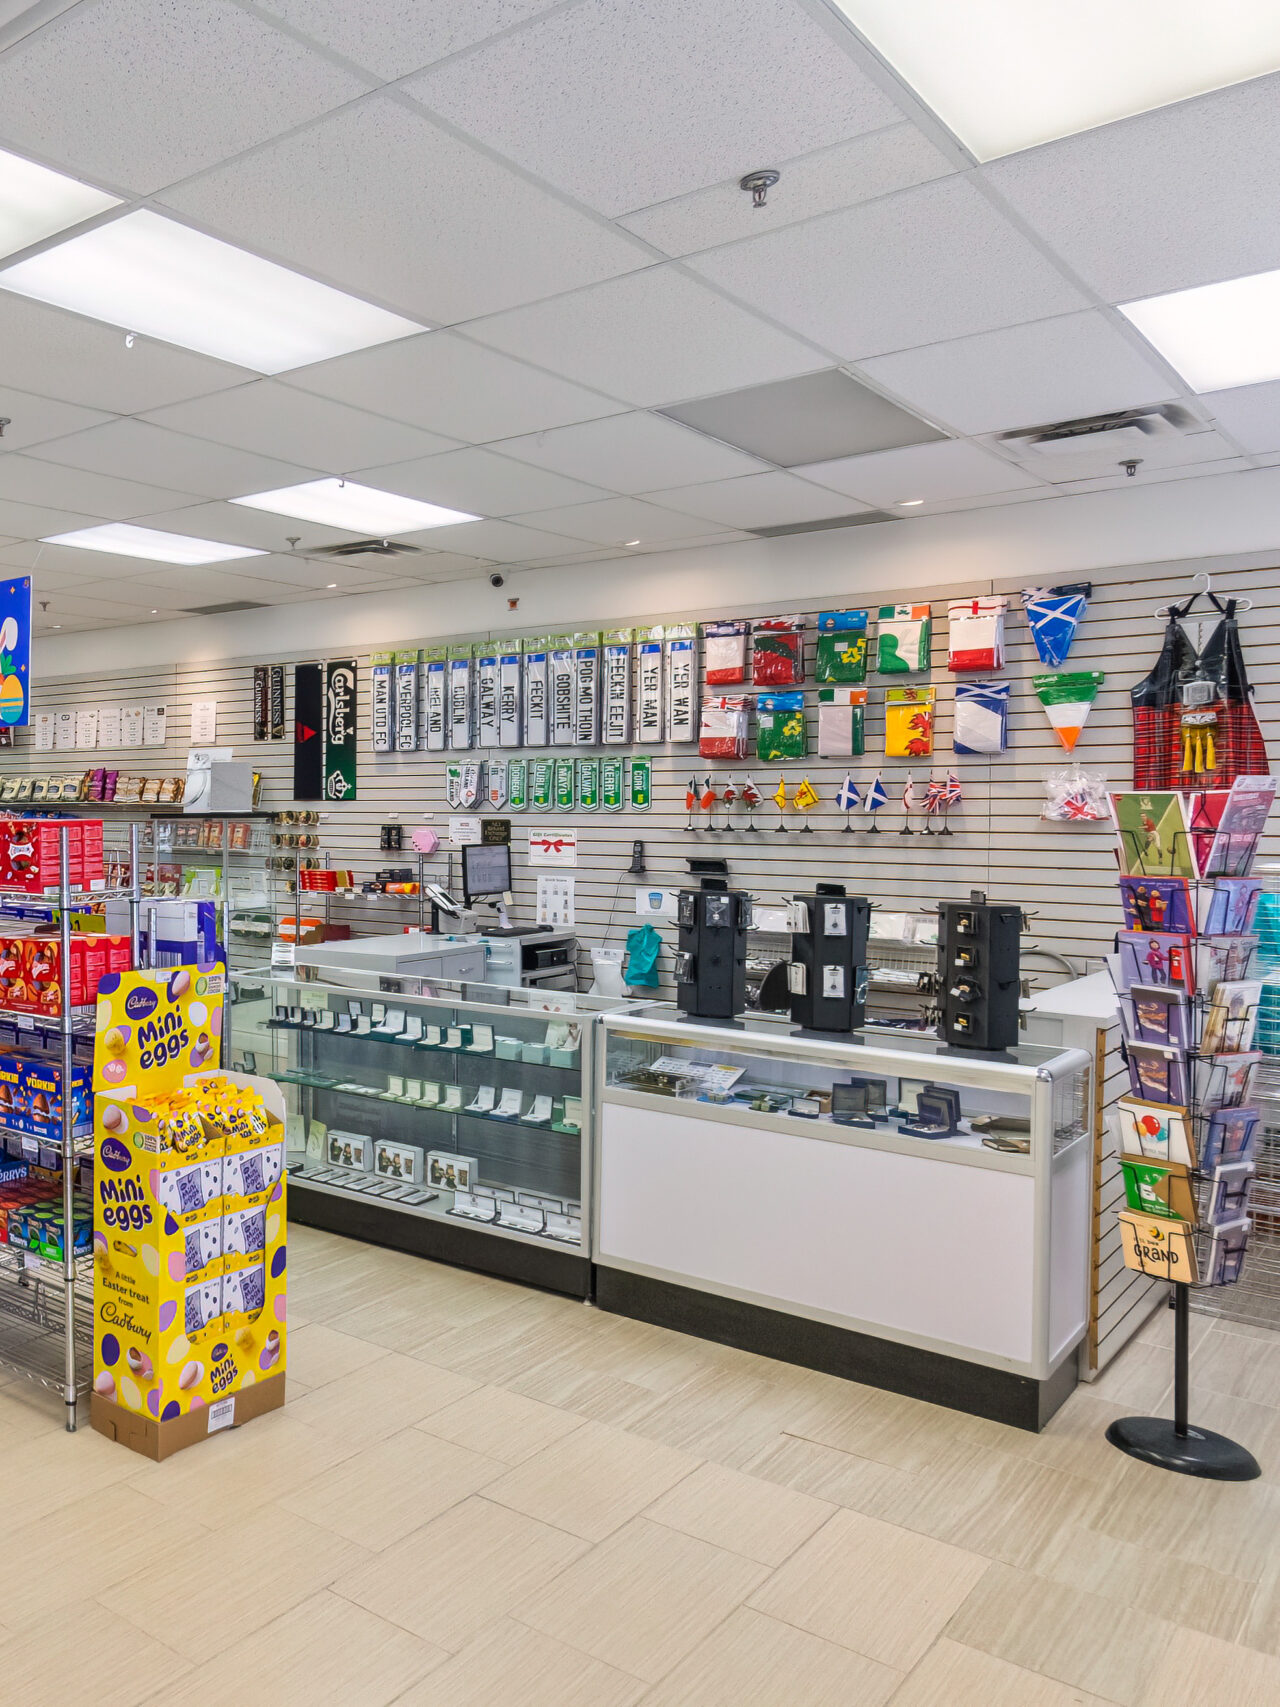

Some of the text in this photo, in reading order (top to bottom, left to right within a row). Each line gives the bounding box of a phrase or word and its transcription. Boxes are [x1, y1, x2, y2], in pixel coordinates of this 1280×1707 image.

[255, 681, 263, 722] GUINNESS
[271, 668, 282, 725] GUINNESS
[328, 668, 355, 745] Carlsberg
[429, 687, 442, 733] IRELAND
[453, 686, 466, 725] DUBLIN
[481, 677, 494, 728] GALWAY
[501, 685, 515, 723] KERRY
[530, 680, 544, 721] FECKIT
[556, 673, 570, 730] GOBSHITE
[579, 687, 593, 704] MO
[375, 680, 387, 745] MAN UTD FC
[578, 707, 593, 741] THOIN
[609, 705, 624, 738] EEJIT
[643, 700, 658, 728] MAN
[673, 697, 689, 726] WAN
[400, 735, 412, 748] FC
[512, 767, 520, 797] DONEGAL
[536, 766, 545, 796] DUBLIN
[558, 767, 567, 794] MAYO
[582, 766, 592, 796] GALWAY
[605, 766, 614, 796] KERRY
[634, 770, 643, 790] CORK
[127, 995, 156, 1010] Cadbury
[138, 1004, 182, 1049] Mini
[140, 1029, 189, 1069] eggs
[181, 1123, 197, 1138] Mini
[185, 1130, 201, 1146] eggs
[232, 1119, 248, 1133] Mini
[103, 1145, 130, 1166] Cadbury
[100, 1174, 144, 1205] Mini
[245, 1169, 260, 1182] Mini
[103, 1204, 153, 1232] eggs
[1134, 1243, 1179, 1264] GRAND
[103, 1277, 149, 1304] Easter treat
[121, 1274, 136, 1285] little
[119, 1296, 133, 1308] from
[100, 1301, 151, 1344] Cadbury
[210, 1353, 234, 1383] Mini
[212, 1366, 238, 1394] eggs
